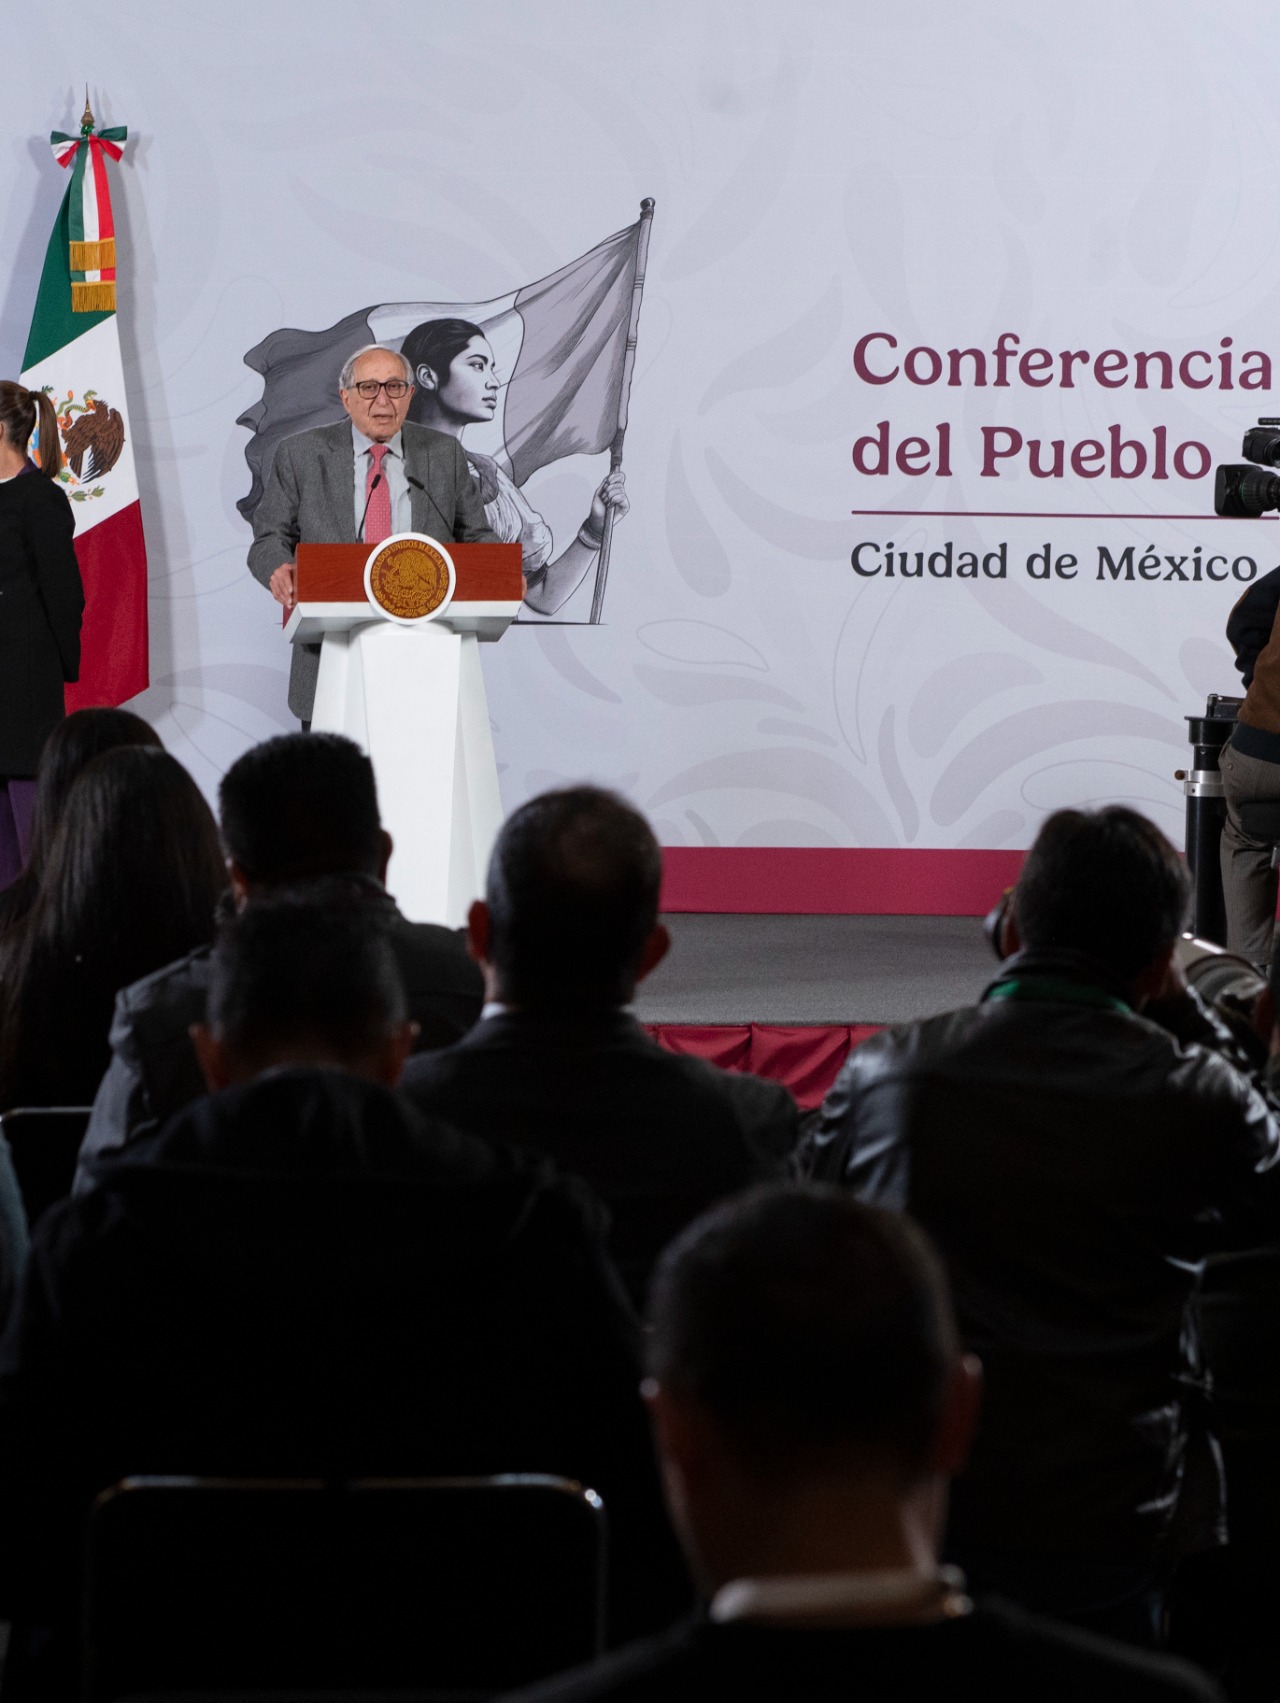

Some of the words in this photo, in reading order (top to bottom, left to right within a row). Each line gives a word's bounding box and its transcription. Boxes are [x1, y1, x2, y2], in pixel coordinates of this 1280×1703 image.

[852, 331, 1272, 391] Conferencia
[851, 420, 953, 477] del
[979, 423, 1212, 480] Pueblo
[390, 540, 418, 551] UNIDOS
[850, 541, 1008, 579] Ciudad
[1026, 542, 1079, 580] de
[1095, 543, 1258, 582] México
